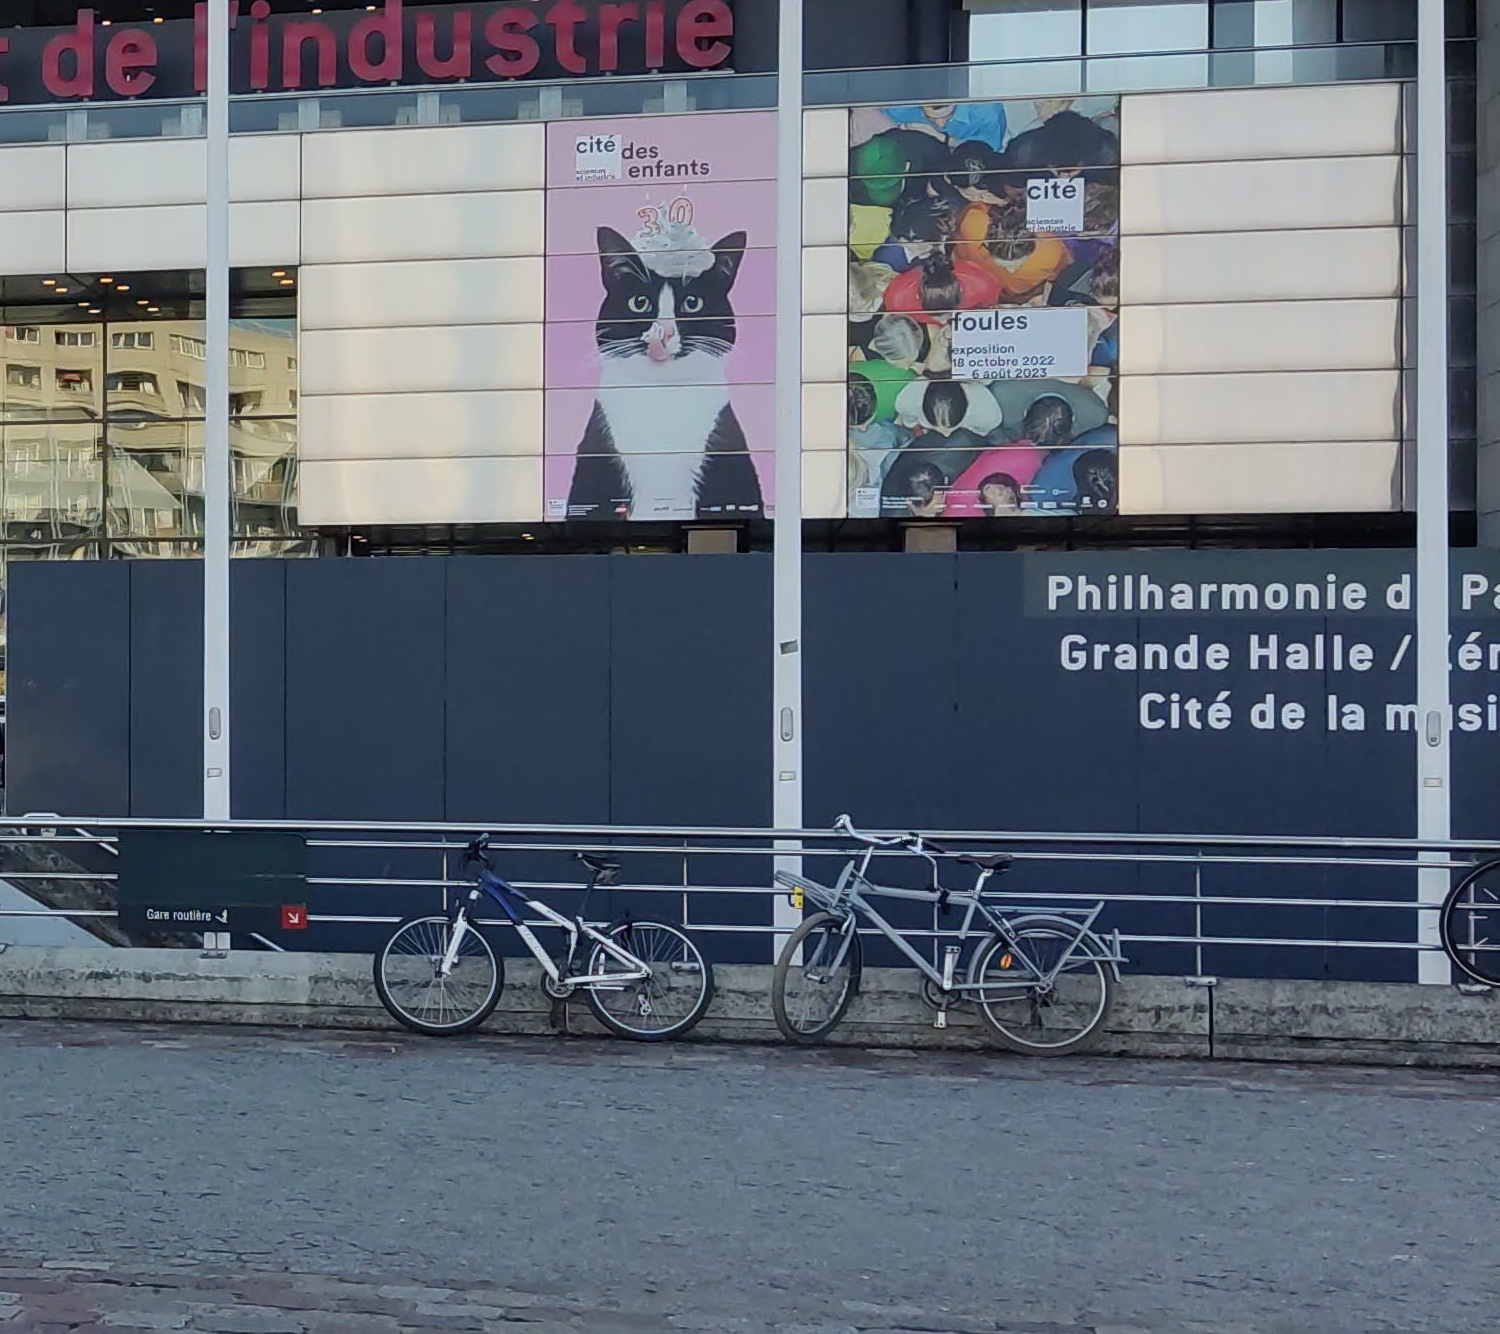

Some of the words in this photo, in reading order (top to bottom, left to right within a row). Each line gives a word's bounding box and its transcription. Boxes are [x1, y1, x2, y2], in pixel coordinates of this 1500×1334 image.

[41, 8, 158, 97] de
[576, 135, 616, 154] cité
[621, 142, 659, 160] des
[628, 159, 710, 178] enfants
[1027, 177, 1077, 200] cité
[952, 310, 1028, 332] foules
[952, 343, 1015, 356] exposition
[953, 358, 965, 368] 18
[968, 356, 1019, 367] octobre
[1022, 355, 1055, 366] 2022
[972, 369, 980, 379] 6
[983, 367, 1012, 378] août
[1015, 367, 1048, 378] 2023
[1048, 573, 1367, 610] Philharmonie
[1060, 634, 1230, 671] Grande
[1249, 634, 1374, 671] Halle
[1139, 690, 1232, 730] Cité
[1250, 693, 1305, 730] de
[1328, 694, 1365, 731] la
[146, 908, 169, 920] Gare
[173, 909, 211, 922] routière
